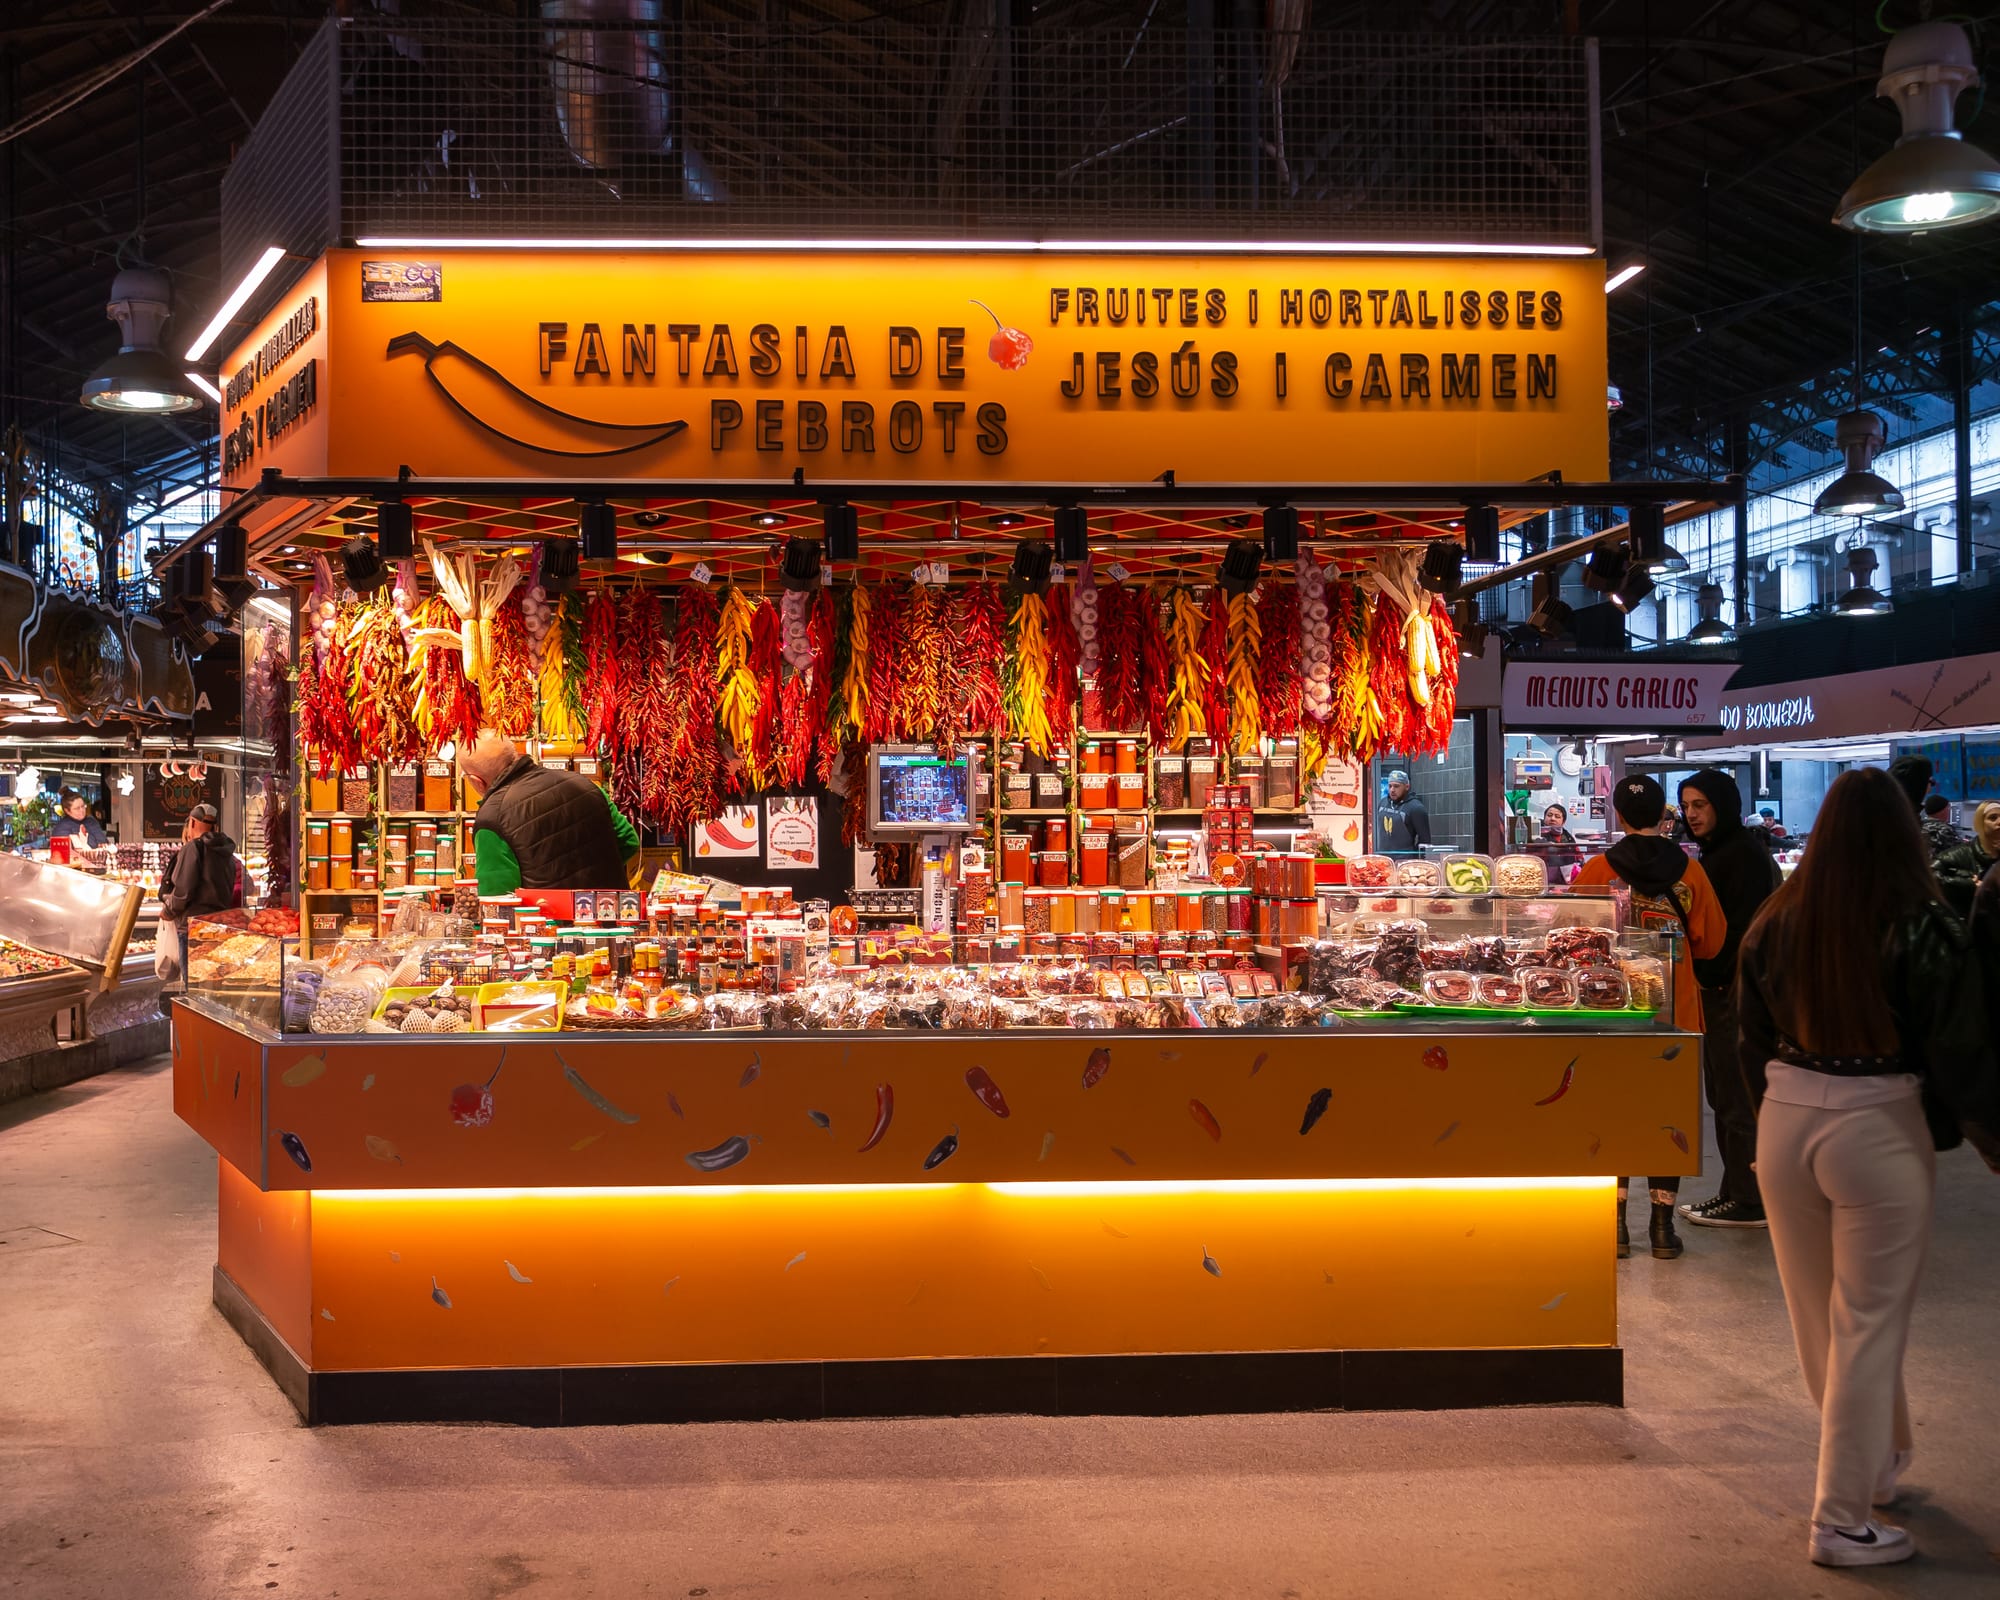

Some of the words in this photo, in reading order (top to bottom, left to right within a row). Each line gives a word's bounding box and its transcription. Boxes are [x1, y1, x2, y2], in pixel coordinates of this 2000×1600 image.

[1050, 287, 1227, 325] FRUITES
[1248, 288, 1259, 325] I
[1280, 288, 1563, 326] HORTALISSES
[255, 351, 262, 383] Y
[262, 296, 316, 377] HORTALIZAS
[539, 322, 856, 379] FANTASIA
[889, 326, 966, 379] DE
[1060, 341, 1239, 399] JESÚS
[1275, 351, 1287, 399] I
[1324, 352, 1557, 399] CARMEN
[255, 405, 264, 448] Y
[266, 358, 316, 440] CARMEN
[711, 399, 1008, 456] PEBROTS
[1526, 676, 1609, 709] MENUTS
[1616, 677, 1699, 709] CARLOS
[1686, 713, 1706, 724] 657
